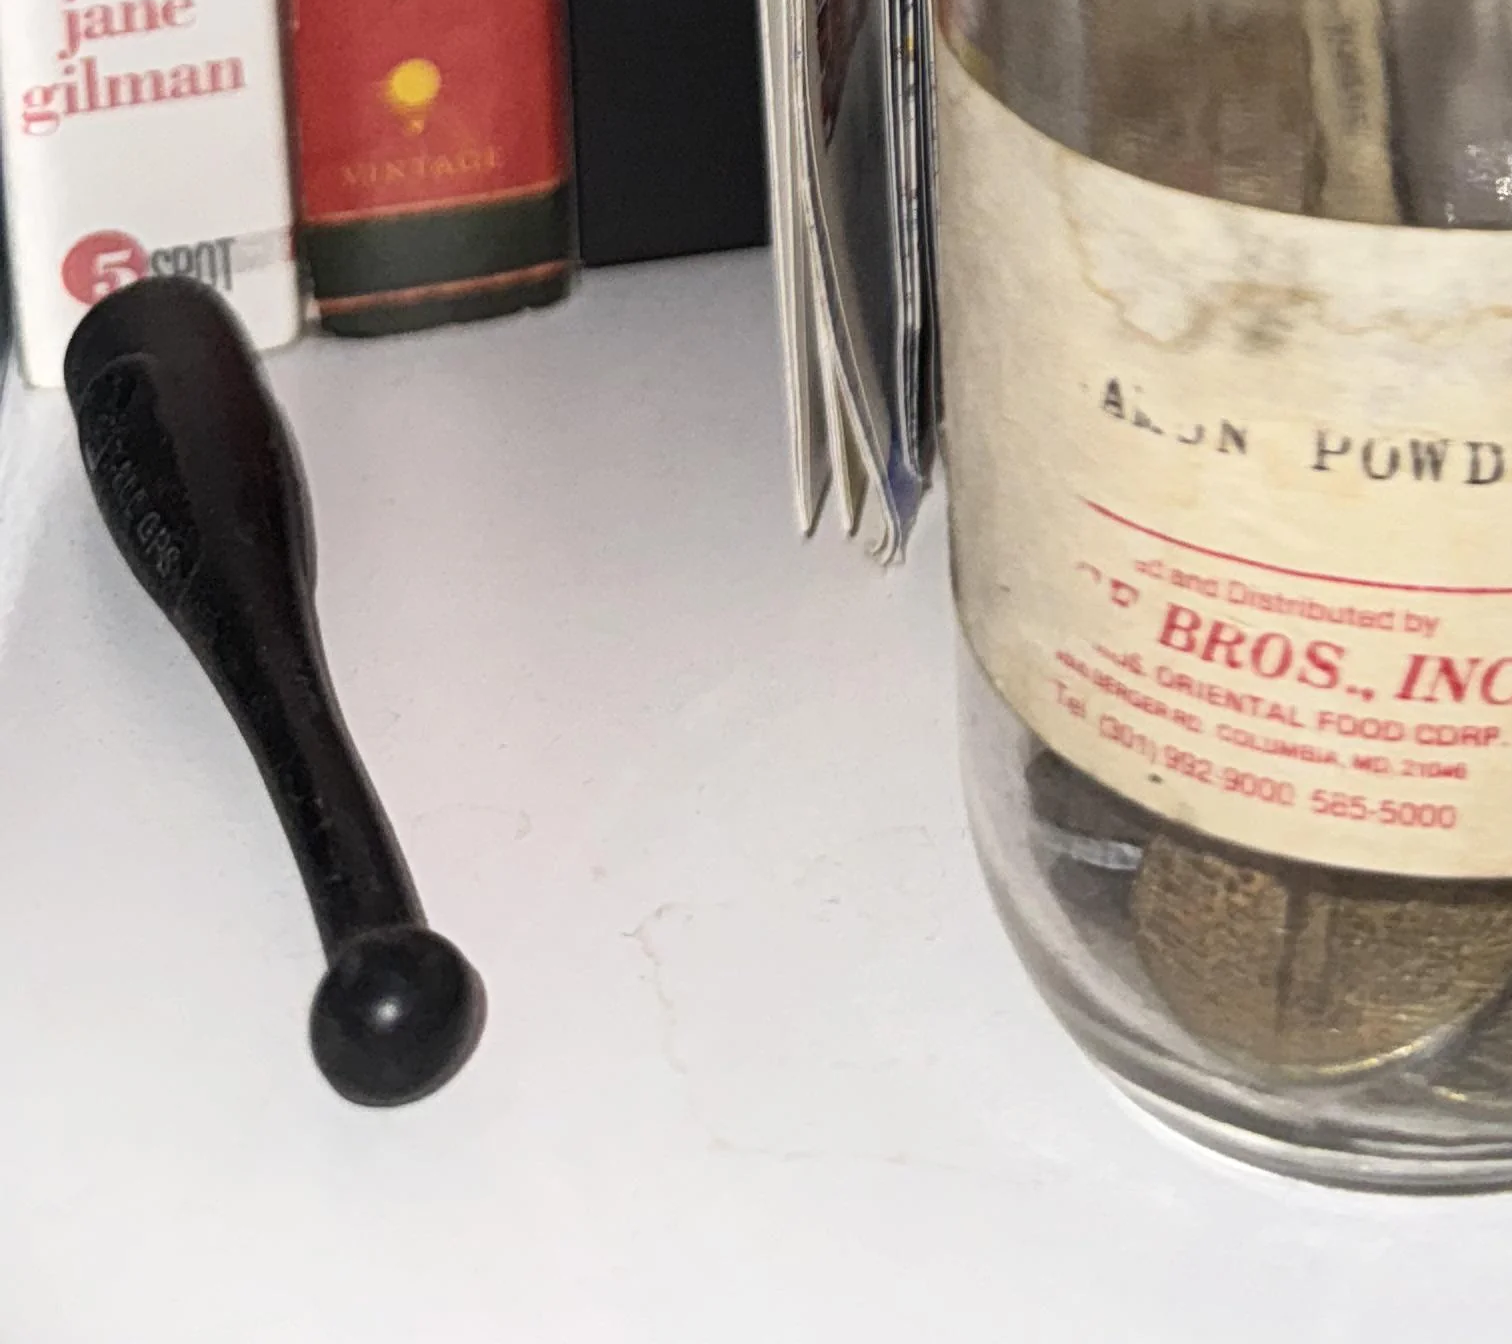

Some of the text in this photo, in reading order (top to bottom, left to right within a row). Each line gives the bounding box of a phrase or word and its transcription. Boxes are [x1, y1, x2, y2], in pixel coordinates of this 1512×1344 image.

[21, 55, 246, 137] gilman
[1227, 579, 1395, 632] Distributed
[1403, 609, 1440, 639] by
[1154, 664, 1306, 729] ORIENTAL
[1315, 709, 1405, 743] FOOD
